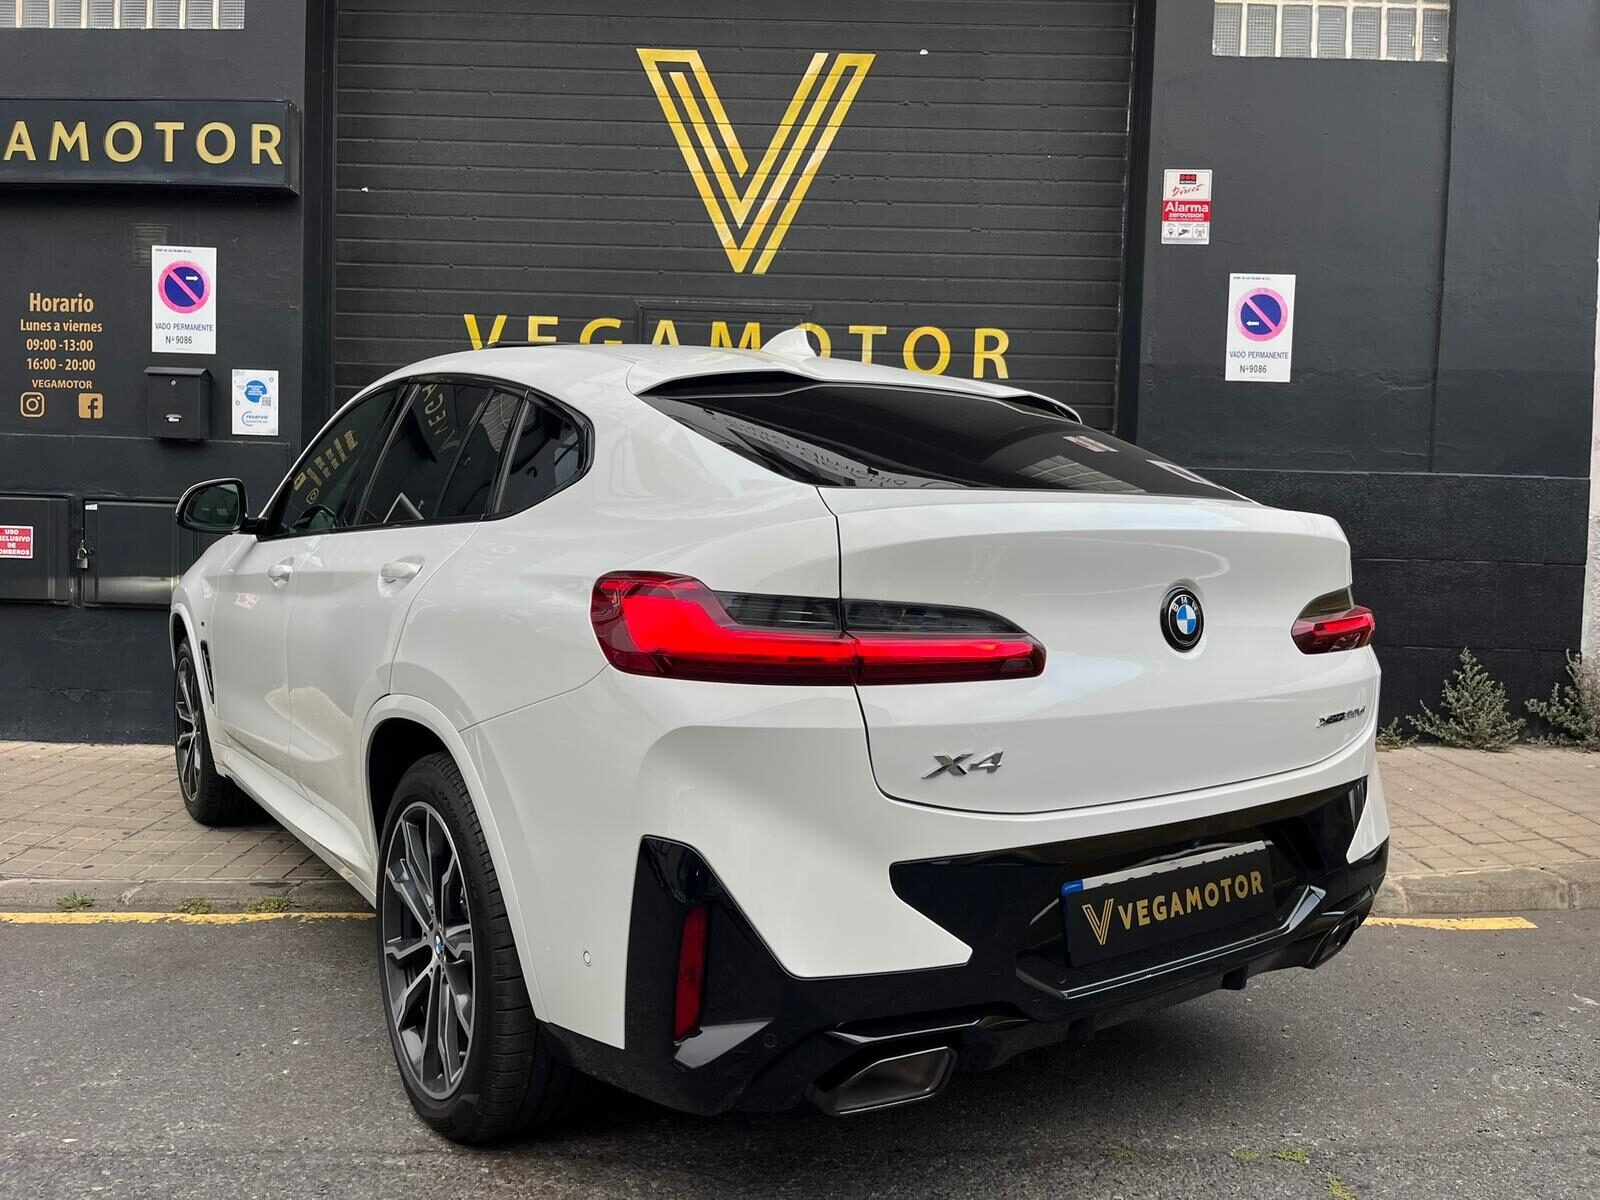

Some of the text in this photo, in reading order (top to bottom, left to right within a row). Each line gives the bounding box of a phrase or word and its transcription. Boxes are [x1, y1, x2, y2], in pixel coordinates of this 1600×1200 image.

[3, 120, 283, 165] AMOTOR
[1165, 201, 1209, 213] Alarma
[29, 292, 94, 312] Horario
[20, 319, 103, 332] Lunes a viernes
[155, 322, 214, 332] VADO PERMANENTE
[26, 339, 56, 351] 09:00
[1248, 351, 1289, 360] PERMANENTE
[26, 358, 56, 370] 16:00
[65, 359, 96, 371] 20:00
[32, 379, 93, 389] VEGAMOTOR
[1171, 596, 1199, 612] BMW
[921, 751, 1004, 780] X4
[1118, 870, 1264, 930] VEGAMOTOR
